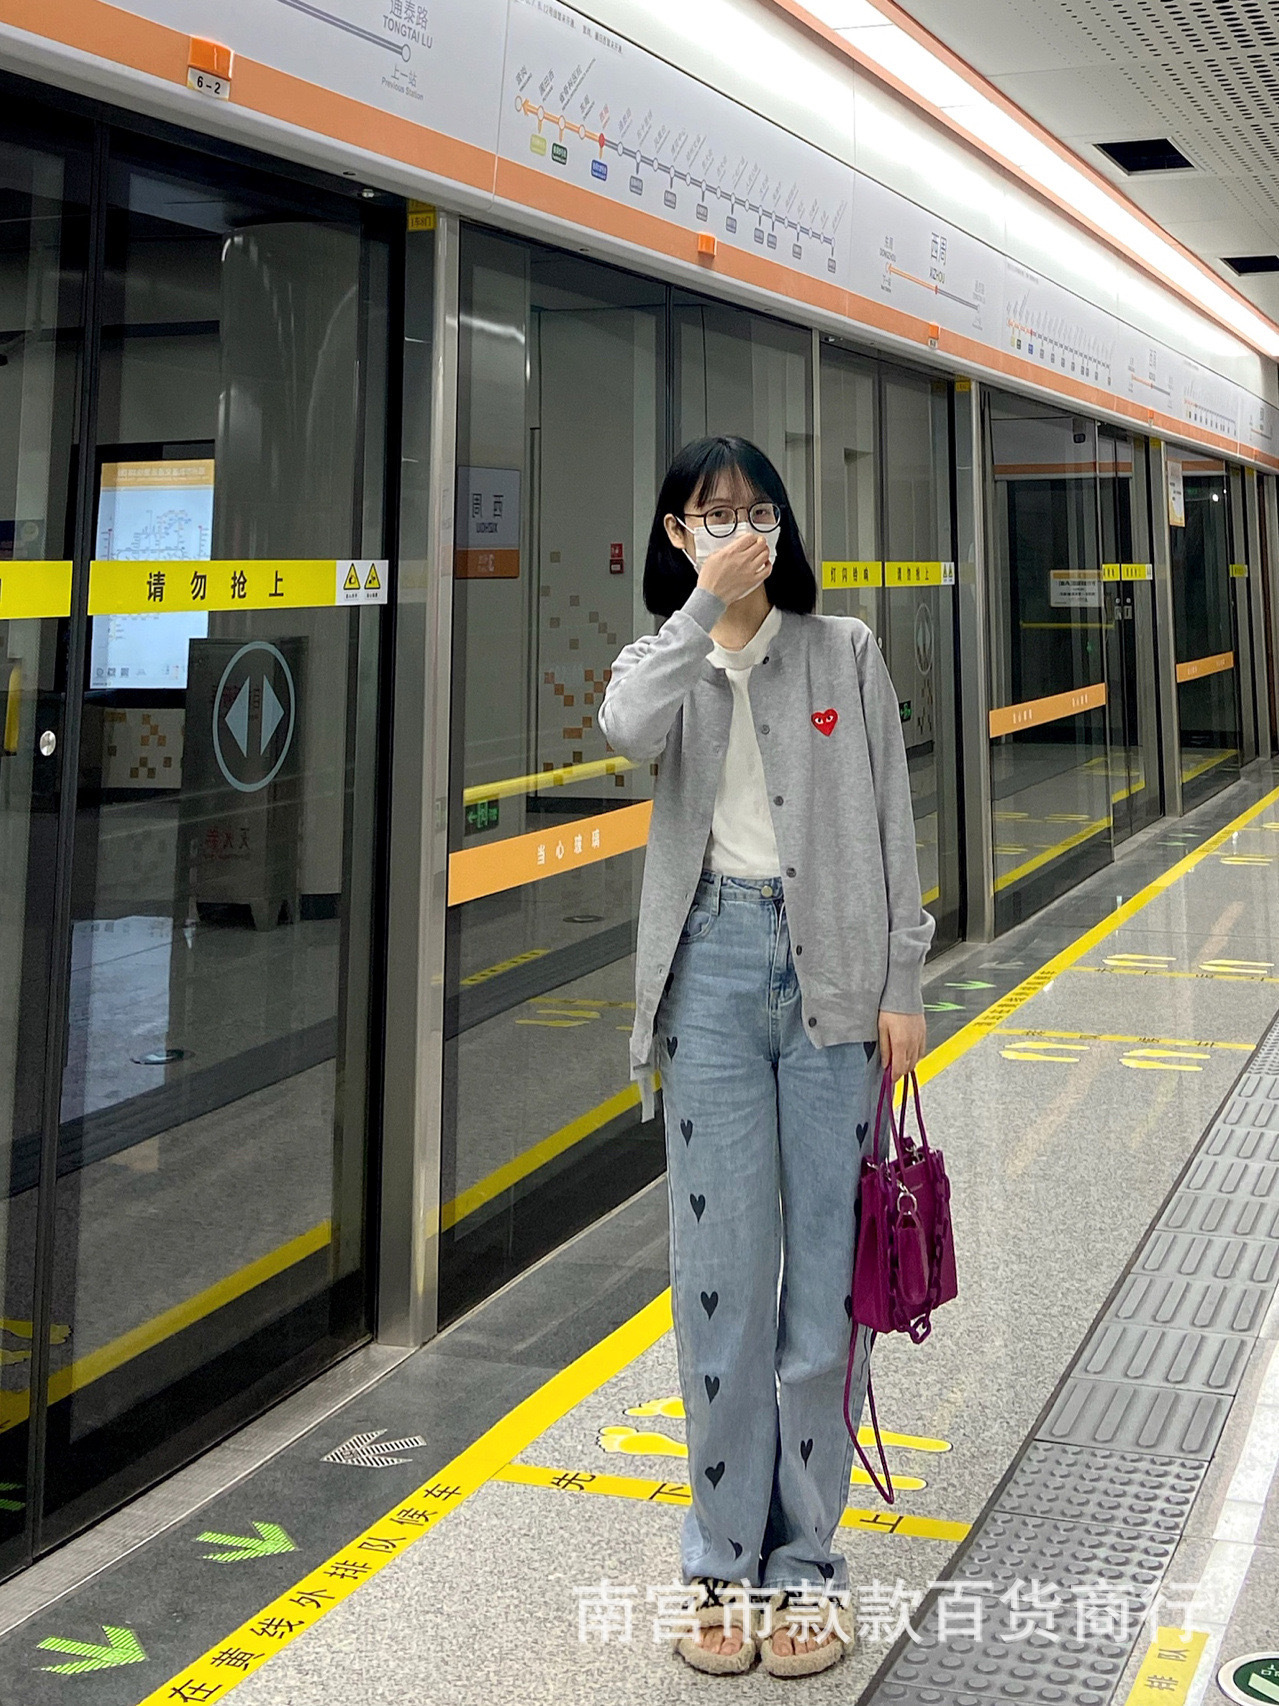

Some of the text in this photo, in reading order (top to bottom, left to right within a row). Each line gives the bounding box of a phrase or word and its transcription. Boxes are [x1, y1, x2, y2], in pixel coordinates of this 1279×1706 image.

[382, 14, 433, 49] TONGTAI LU
[390, 0, 428, 30] 通泰路
[196, 75, 221, 95] 6-2
[381, 76, 424, 101] Previous Station
[391, 63, 417, 87] 上一站
[930, 231, 947, 266] 西周
[146, 569, 284, 602] 请勿抢上
[536, 827, 601, 865] 当心玻璃
[167, 1483, 462, 1704] 在黄线外排队候车
[1144, 1647, 1190, 1692] 排队
